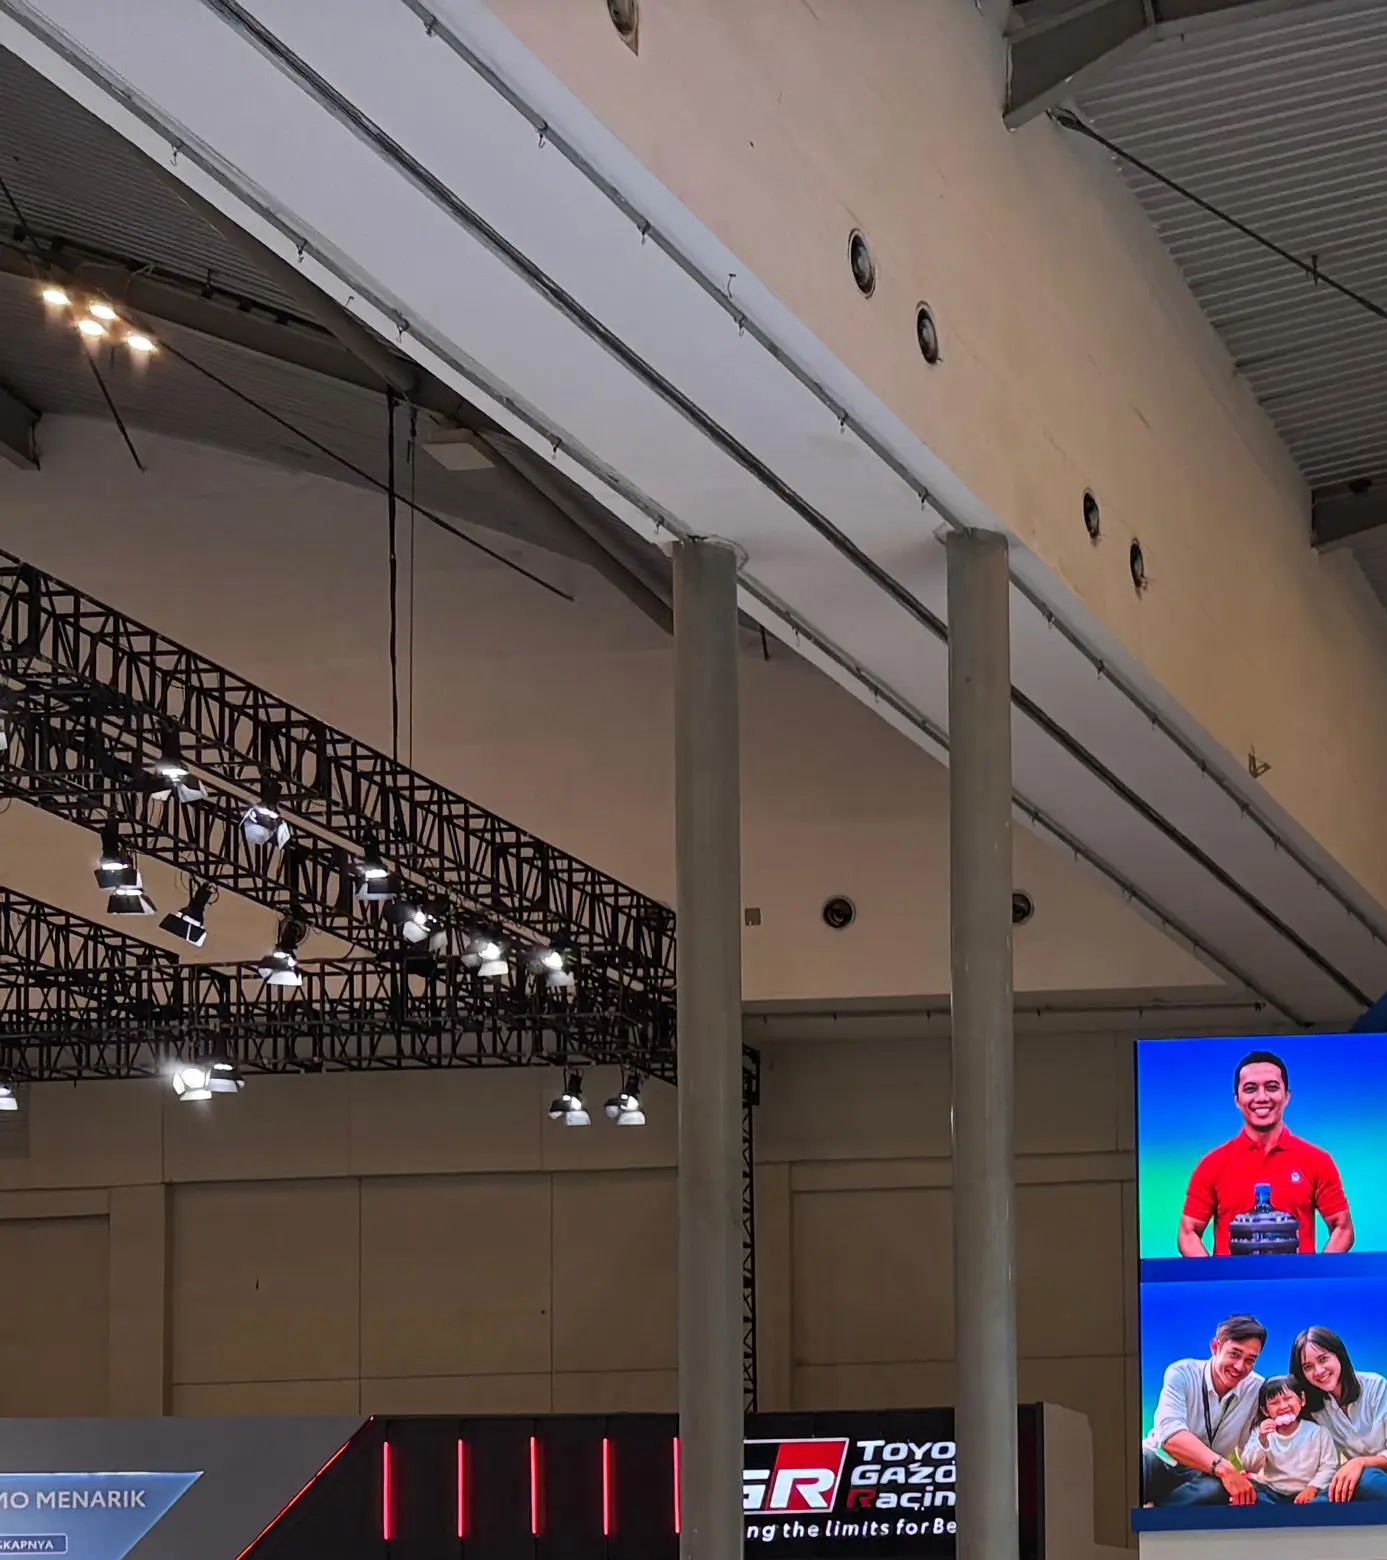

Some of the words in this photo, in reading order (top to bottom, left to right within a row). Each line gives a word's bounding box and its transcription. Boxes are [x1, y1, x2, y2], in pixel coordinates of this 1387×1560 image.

[36, 1490, 146, 1509] MENARIK
[783, 1520, 819, 1537] the
[825, 1519, 890, 1537] limits
[896, 1518, 929, 1535] for
